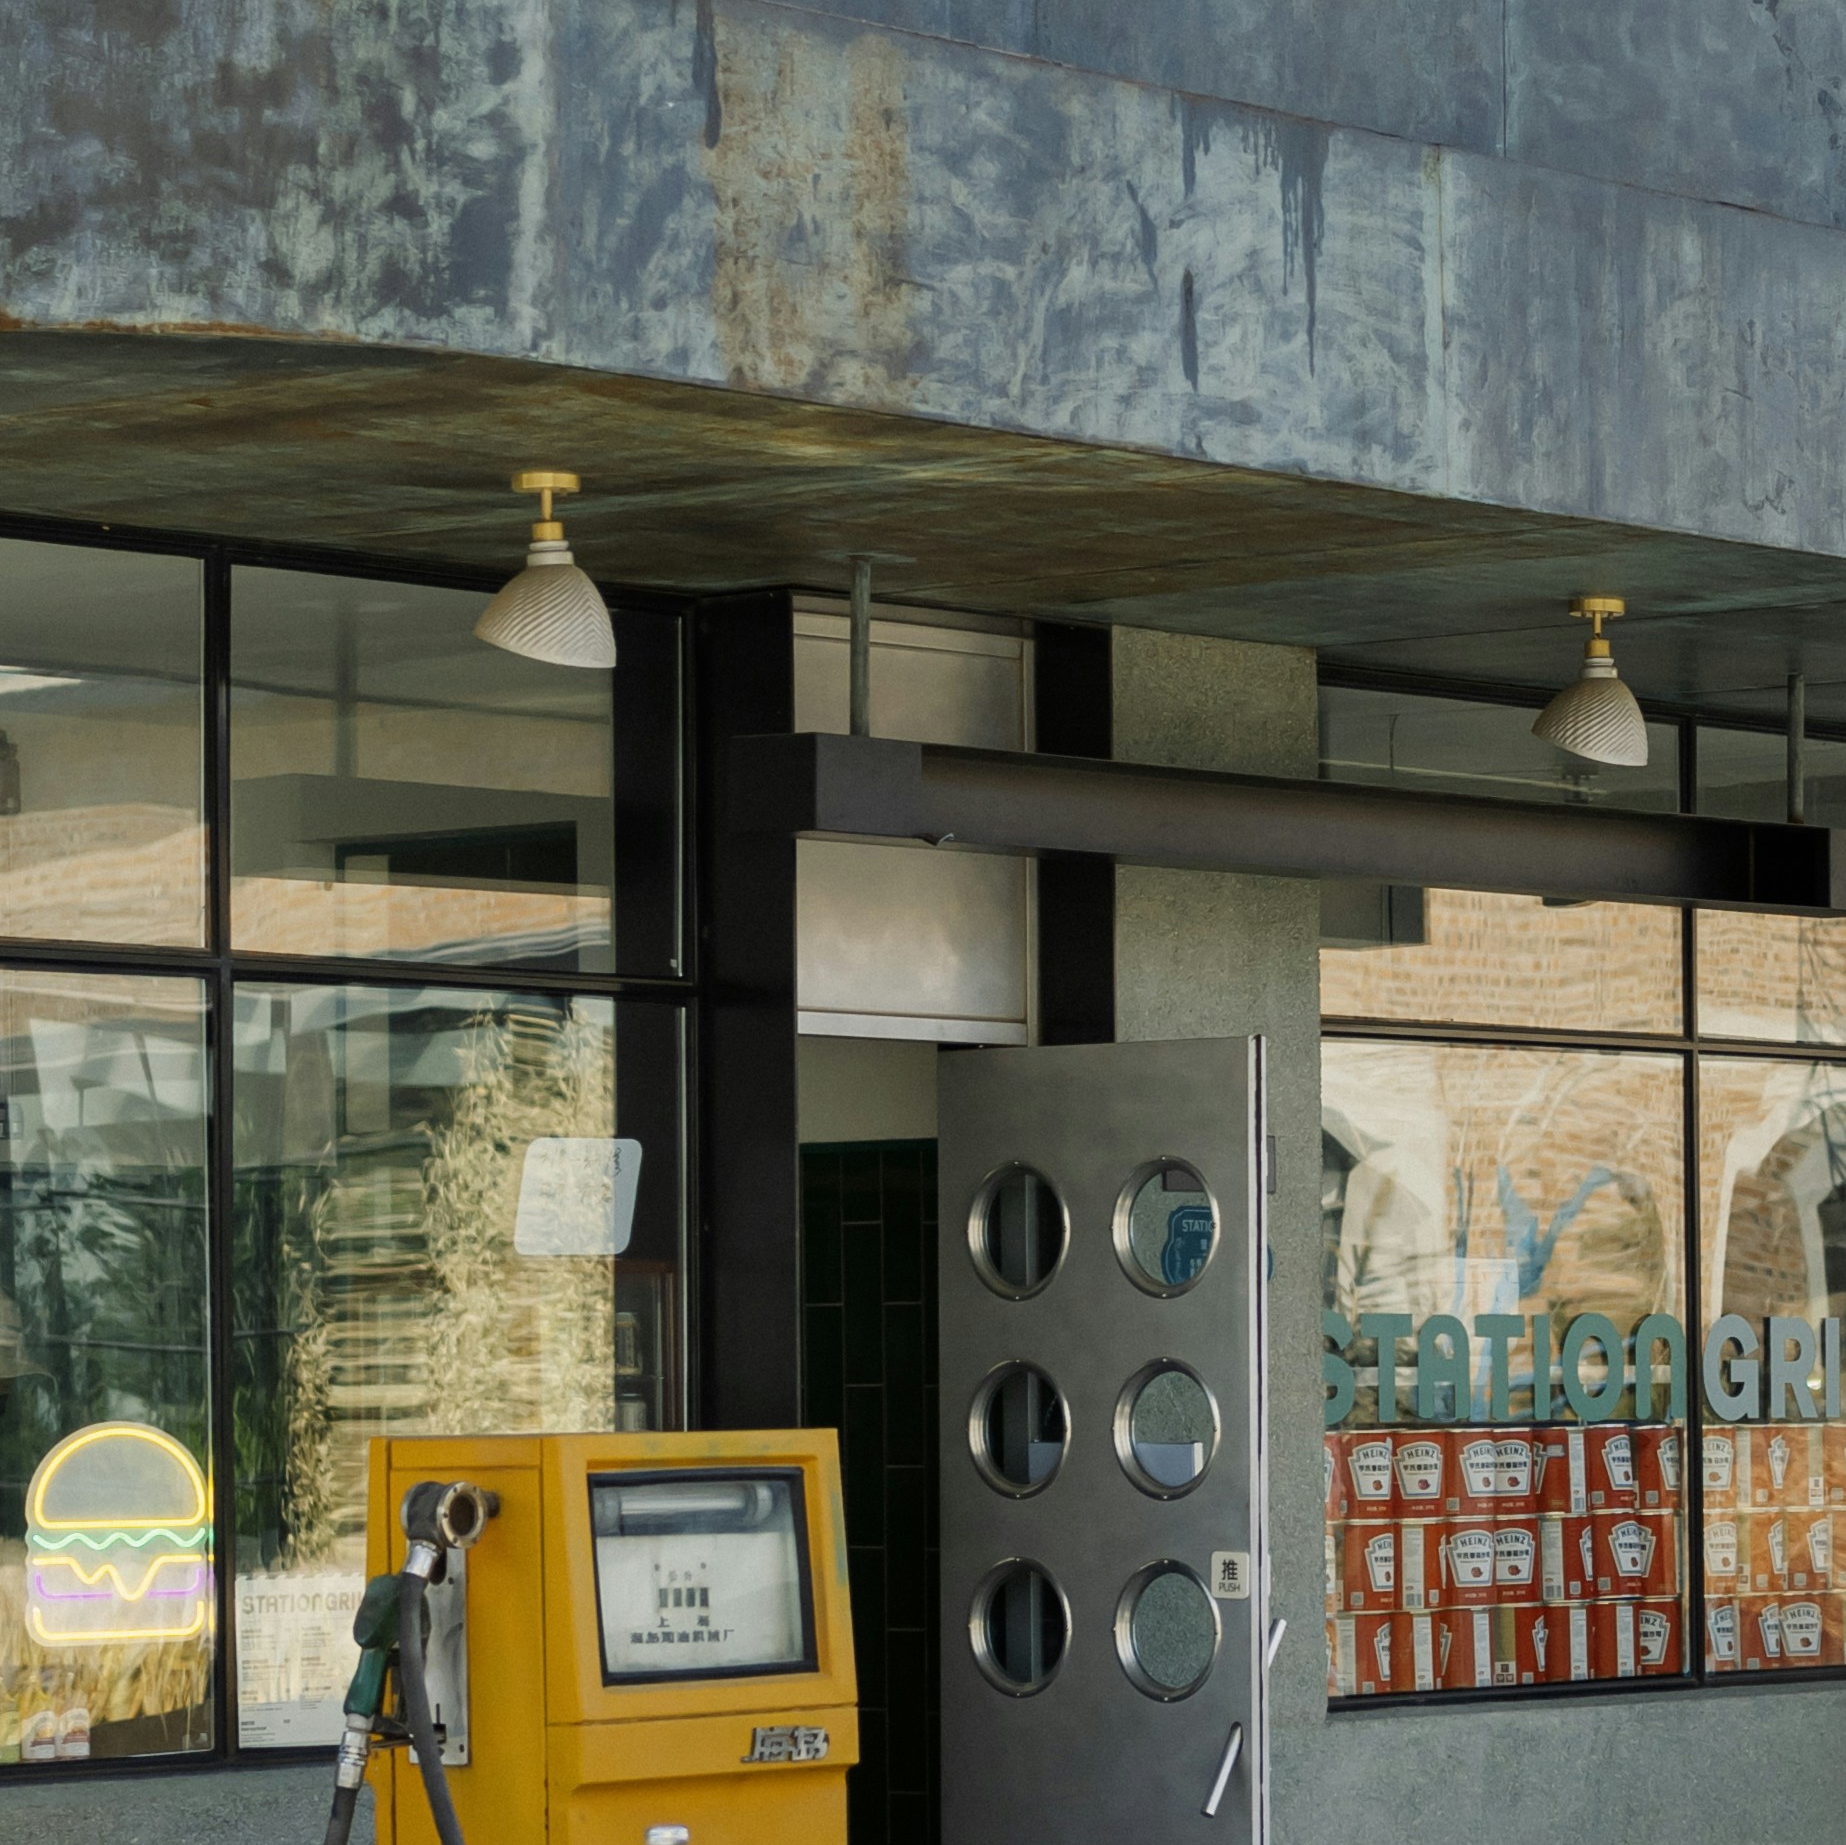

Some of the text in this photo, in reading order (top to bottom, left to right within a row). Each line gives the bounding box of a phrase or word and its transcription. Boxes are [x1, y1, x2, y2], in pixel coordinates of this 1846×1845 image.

[1406, 1448, 1436, 1459] HEINZ
[1459, 1536, 1488, 1548] HEINZ
[1222, 1559, 1238, 1581] 推
[1219, 1582, 1240, 1592] PUSH
